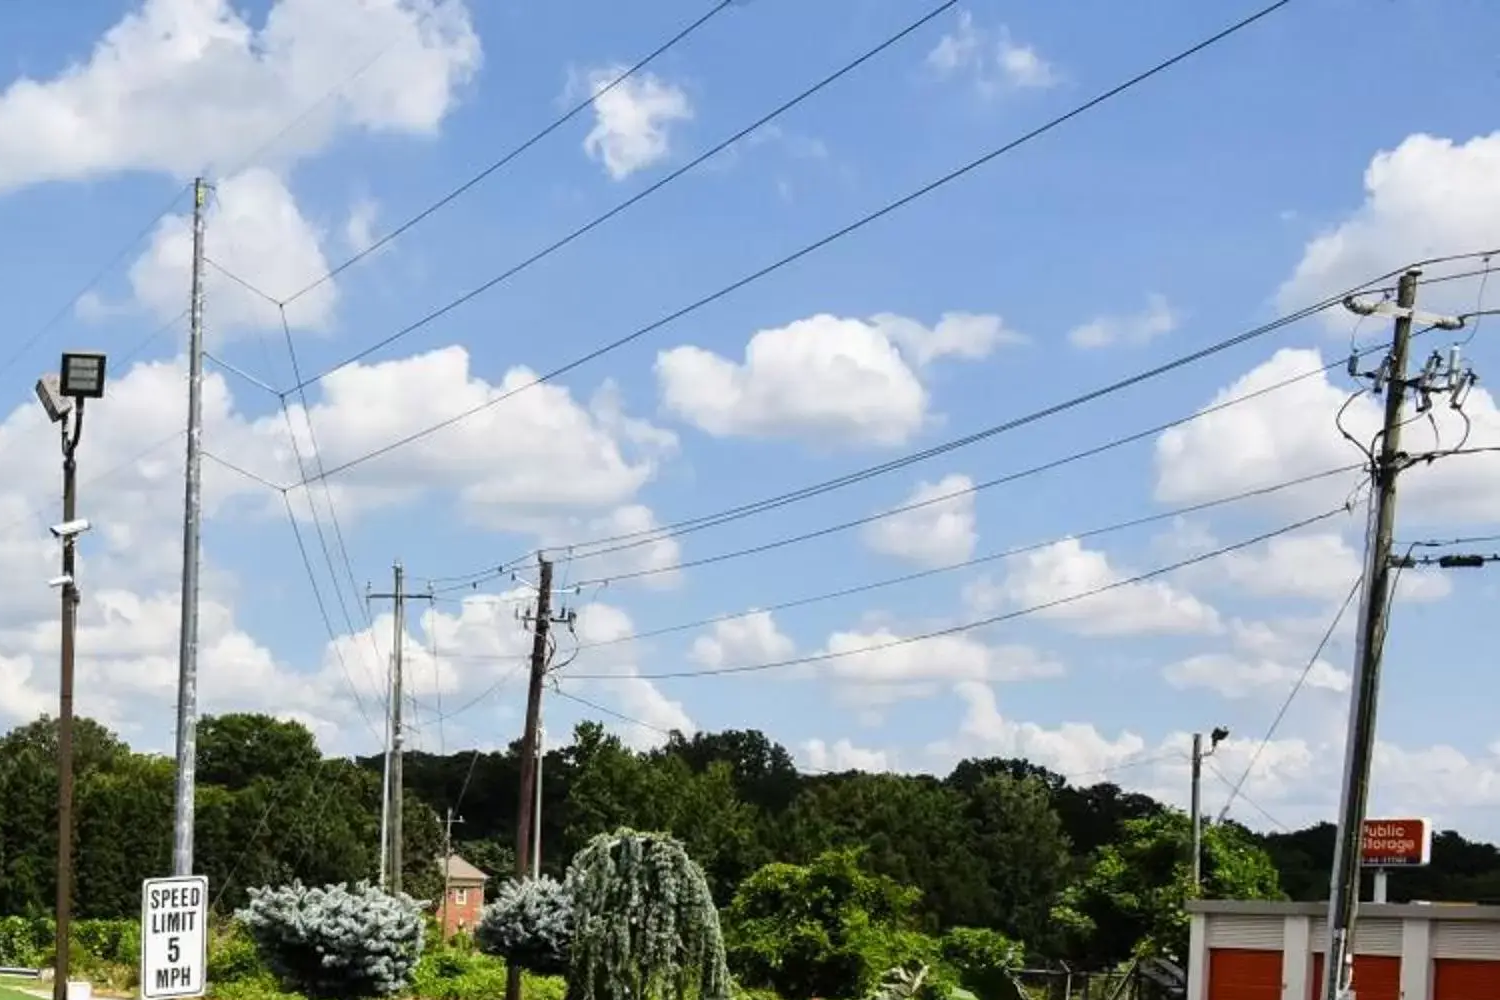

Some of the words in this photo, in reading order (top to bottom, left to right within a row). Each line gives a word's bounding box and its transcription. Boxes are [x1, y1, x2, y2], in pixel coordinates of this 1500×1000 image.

[150, 887, 200, 909] SPEED
[152, 911, 196, 933] LIMIT
[167, 936, 180, 963] 5
[156, 965, 191, 988] MPH
